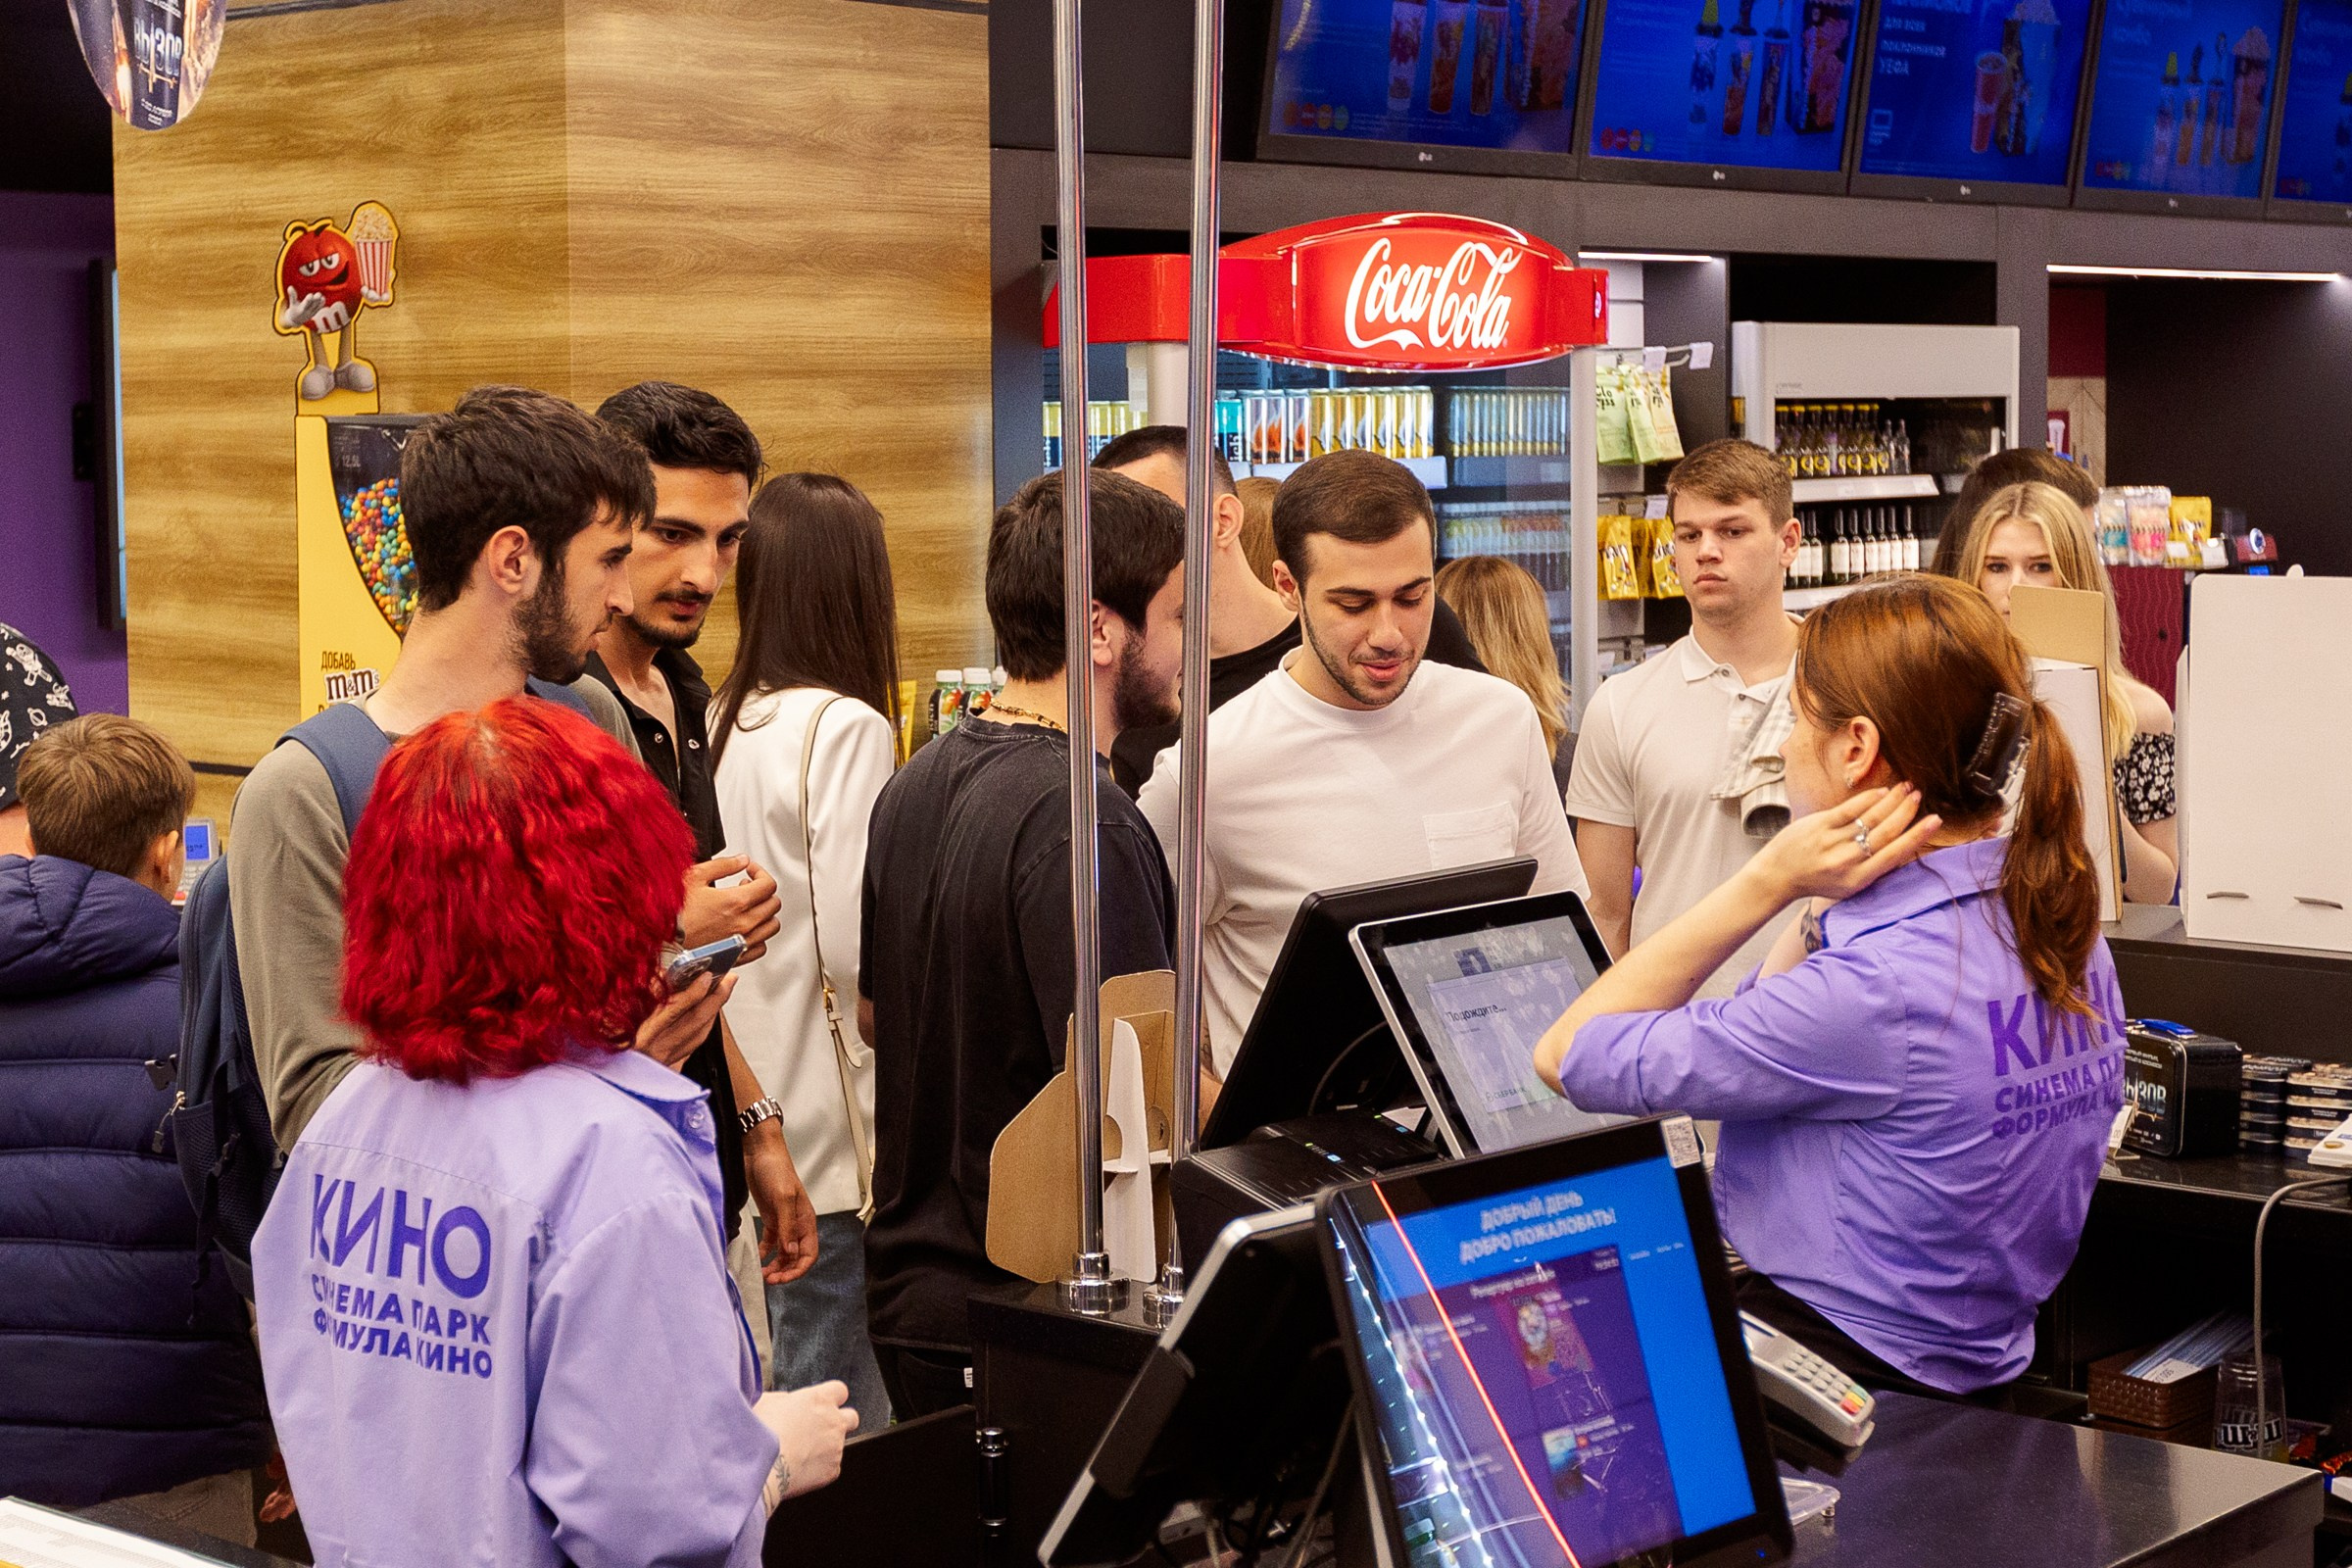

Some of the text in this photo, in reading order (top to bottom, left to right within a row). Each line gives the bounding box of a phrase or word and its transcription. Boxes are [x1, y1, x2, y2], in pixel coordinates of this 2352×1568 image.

[1345, 237, 1523, 351] Coca-Cola
[320, 651, 357, 671] ДОБАВЬ
[1494, 1086, 1527, 1099] СБЕРБАК
[1995, 1063, 2097, 1113] СИНЕМА
[2124, 1076, 2167, 1115] ЫЗОВ
[1480, 1191, 1584, 1233] ДОБРЫЙ ДЕНЬ
[310, 1173, 492, 1300] КИНО
[1459, 1231, 1513, 1266] ДОБРО
[314, 1307, 493, 1380] ФМУЛА КИНО
[412, 1299, 491, 1347] ПАРК
